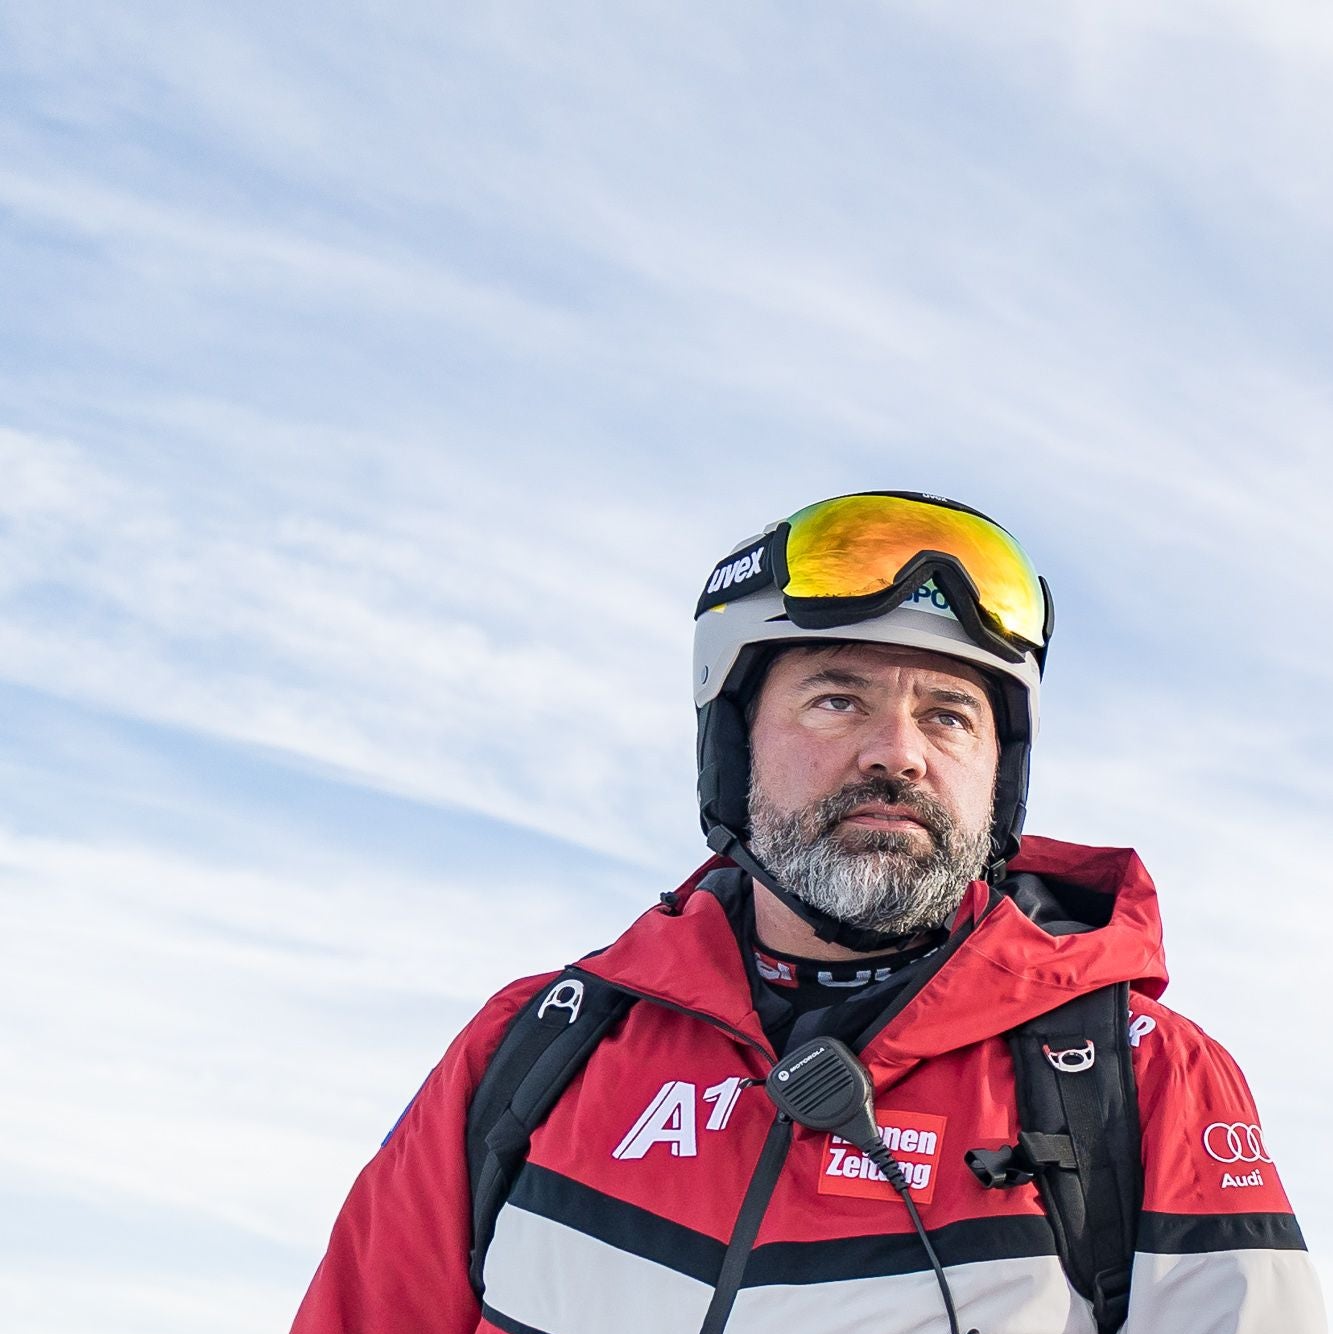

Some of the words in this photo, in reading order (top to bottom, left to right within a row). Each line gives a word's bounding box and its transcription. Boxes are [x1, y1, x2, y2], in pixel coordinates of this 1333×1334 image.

[707, 546, 765, 595] uvex
[789, 1047, 825, 1073] MOTOROLA
[611, 1076, 744, 1161] A1
[1221, 1169, 1264, 1189] Audi
